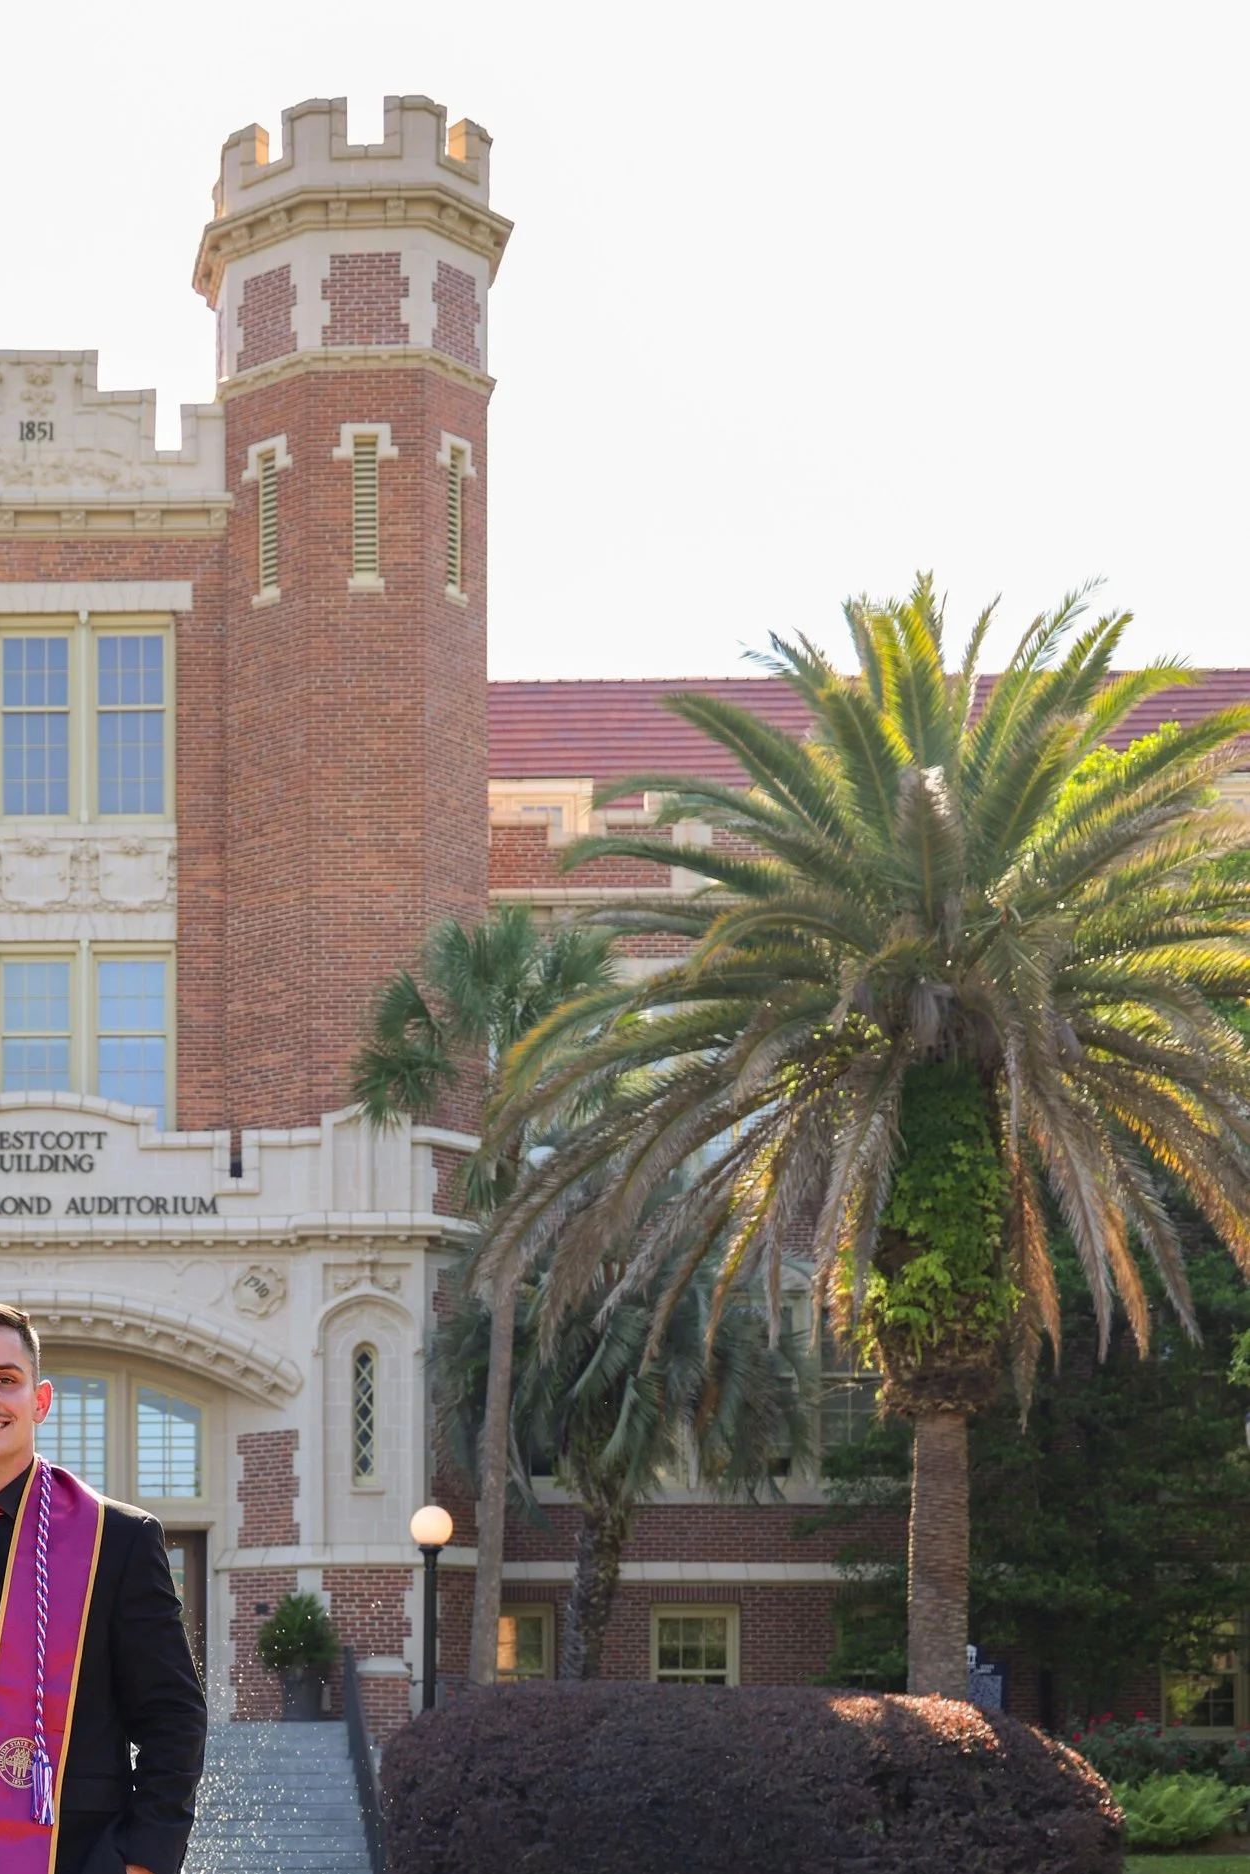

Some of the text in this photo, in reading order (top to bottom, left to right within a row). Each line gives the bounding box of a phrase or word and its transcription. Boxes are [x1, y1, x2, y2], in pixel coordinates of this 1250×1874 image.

[18, 420, 54, 441] 1851
[65, 1196, 219, 1216] AUDITORIUM
[243, 1275, 270, 1298] 1910
[10, 1740, 29, 1748] STATE
